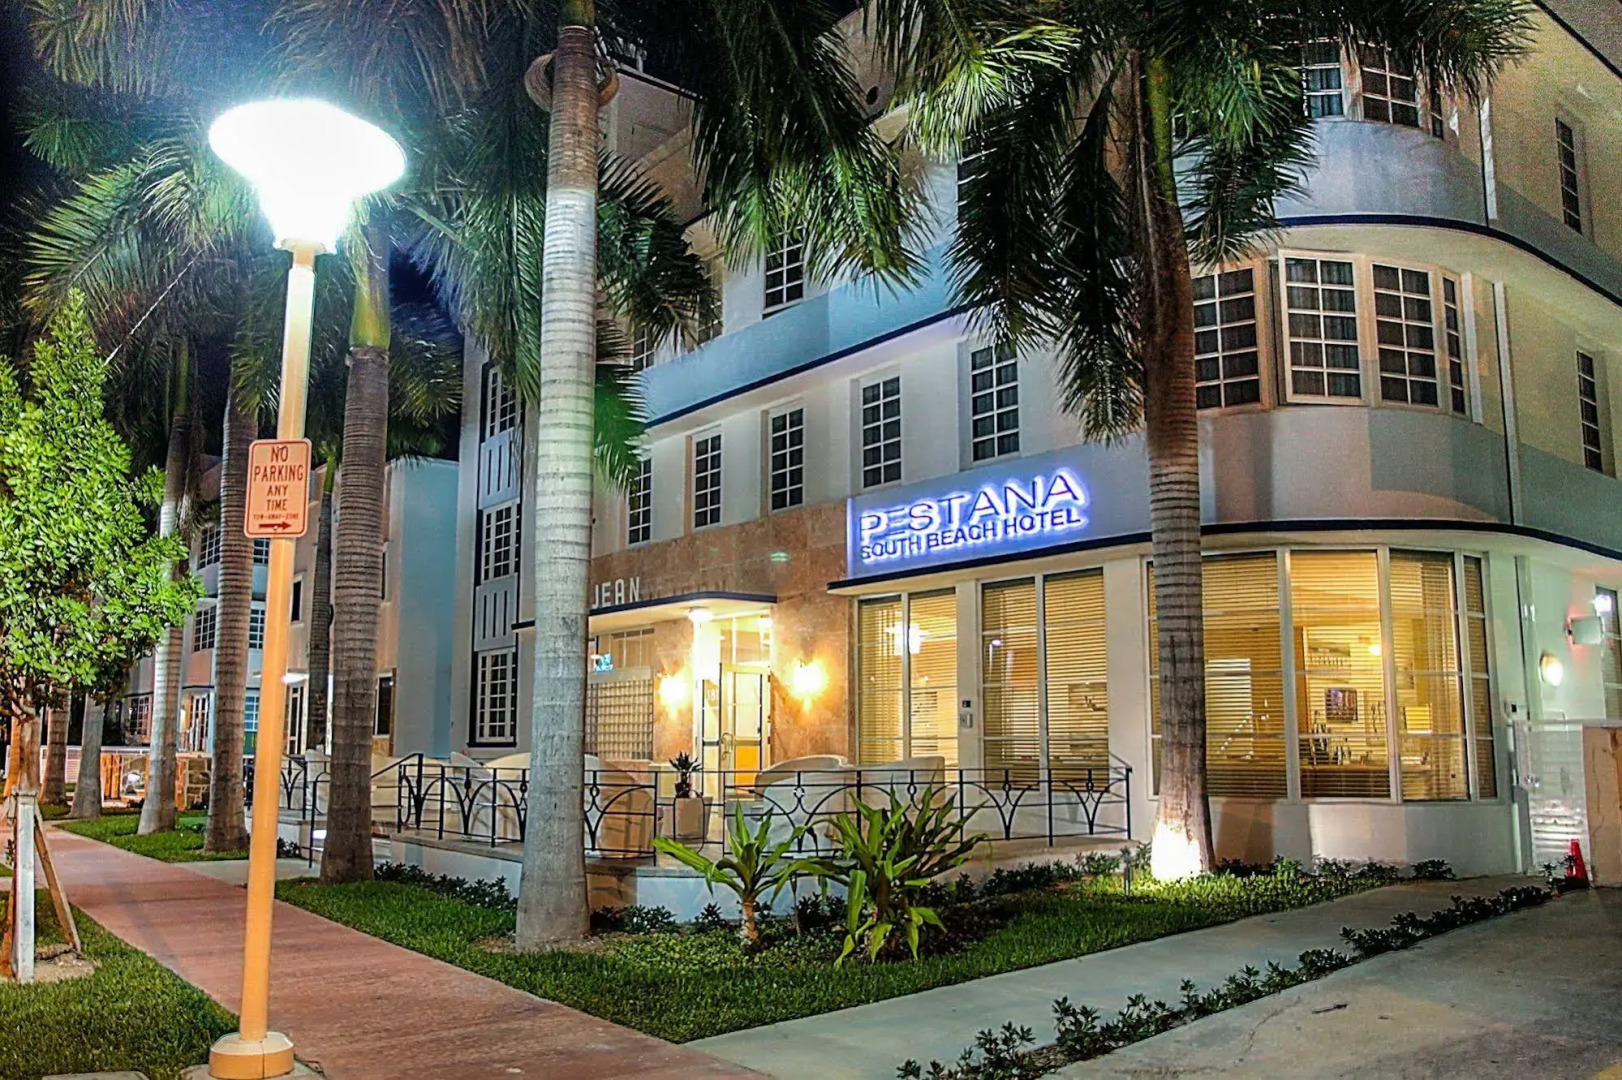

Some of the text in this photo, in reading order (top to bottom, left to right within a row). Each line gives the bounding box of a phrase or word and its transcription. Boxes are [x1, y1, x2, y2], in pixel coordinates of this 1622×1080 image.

[271, 446, 288, 462] NO
[254, 464, 304, 482] PARKING
[267, 484, 289, 496] ANY
[266, 499, 287, 511] TIME
[859, 473, 1081, 543] PESTANA
[860, 507, 1081, 560] SOUTH BEACH HOTEL
[592, 576, 640, 609] JEAN
